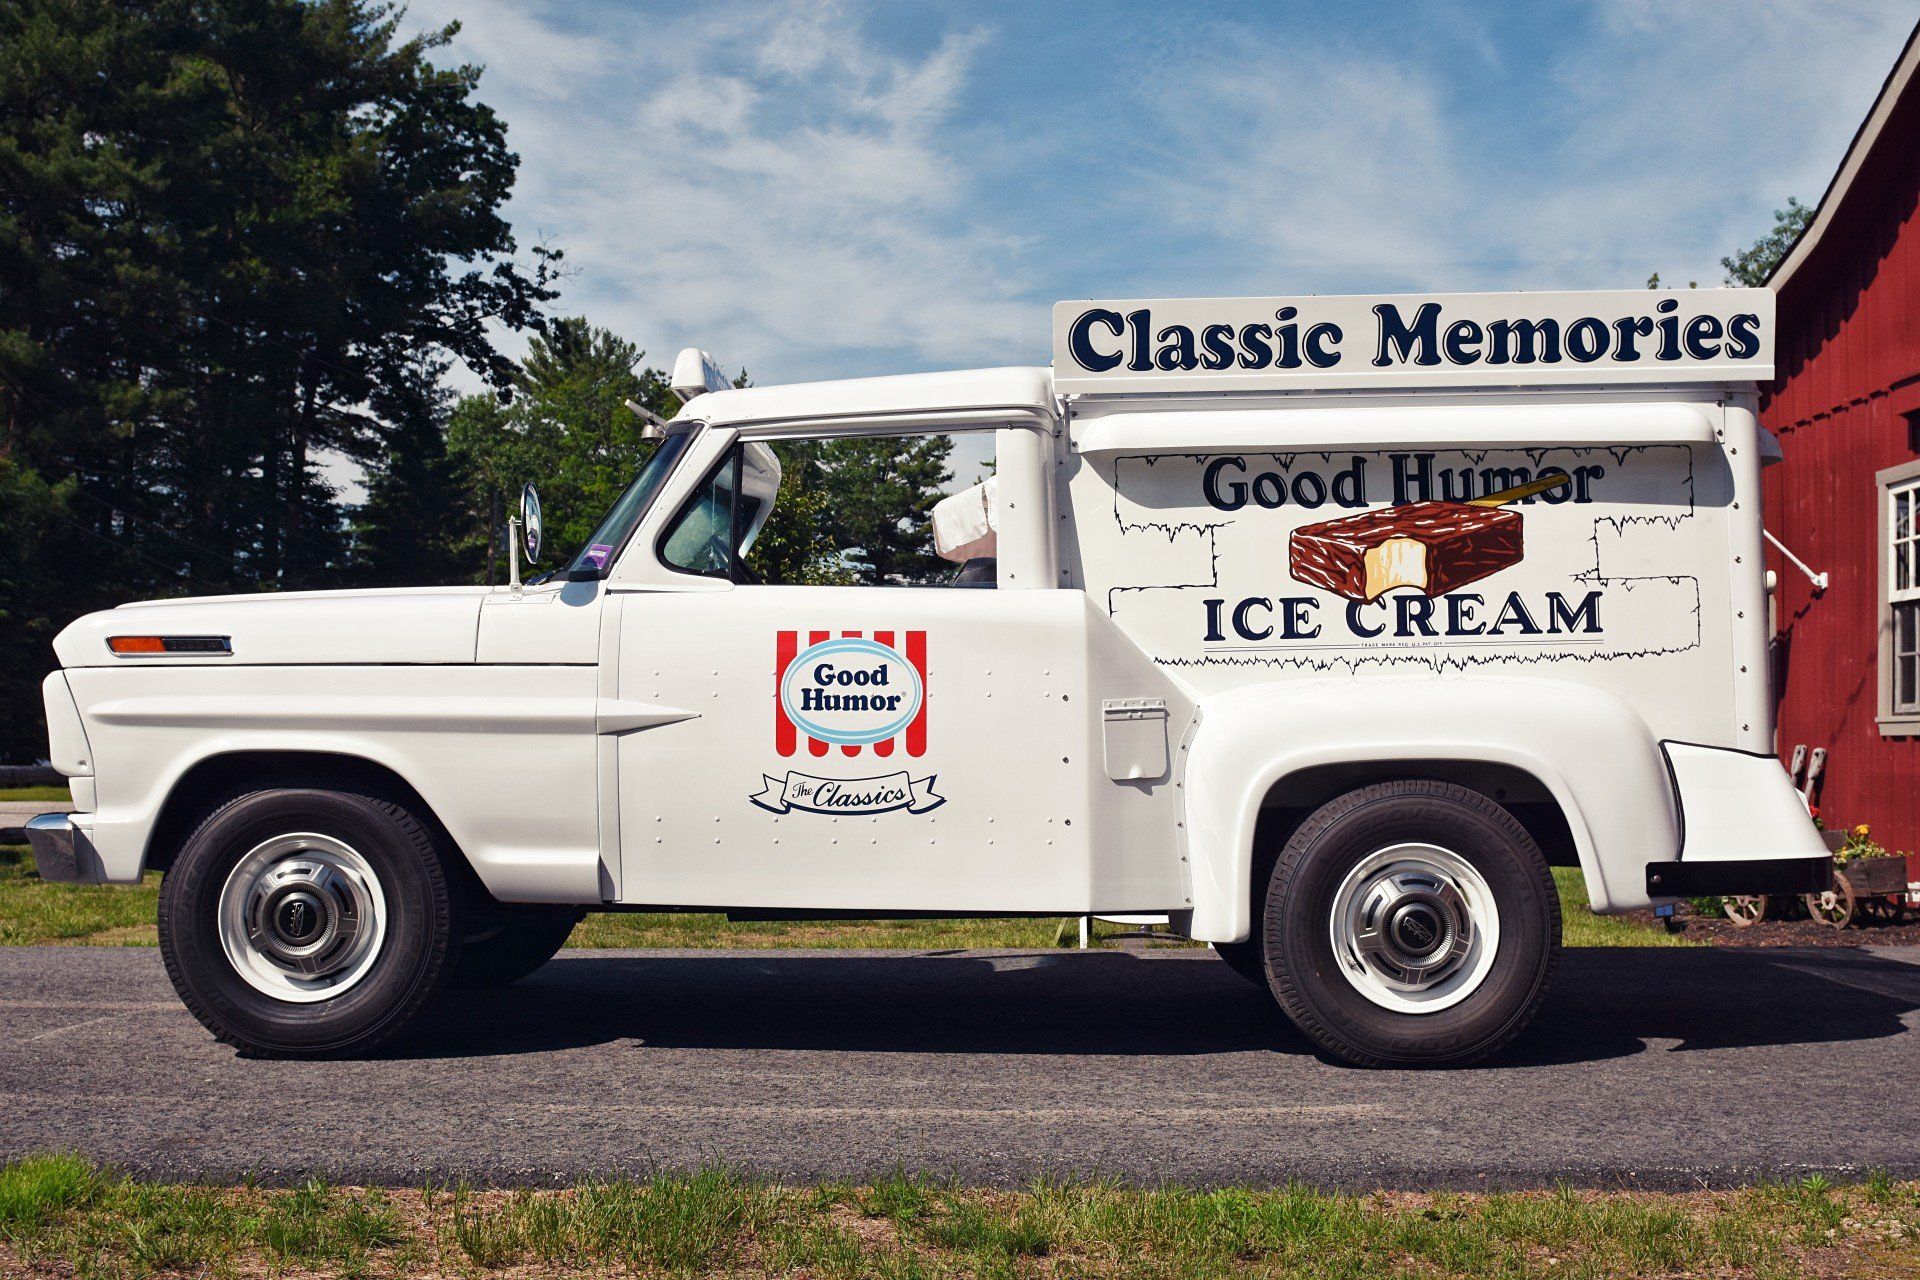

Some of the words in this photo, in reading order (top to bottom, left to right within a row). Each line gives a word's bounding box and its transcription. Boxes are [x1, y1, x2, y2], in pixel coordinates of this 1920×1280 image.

[1068, 306, 1343, 372] Classic
[1372, 299, 1760, 367] Memories
[1203, 455, 1369, 511] Good
[1388, 453, 1605, 507] Humor
[1203, 597, 1322, 641] ICE
[1346, 591, 1604, 638] CREAM
[814, 664, 889, 686] Good
[801, 688, 901, 711] Humor
[791, 781, 814, 799] The
[813, 782, 906, 807] Classics
